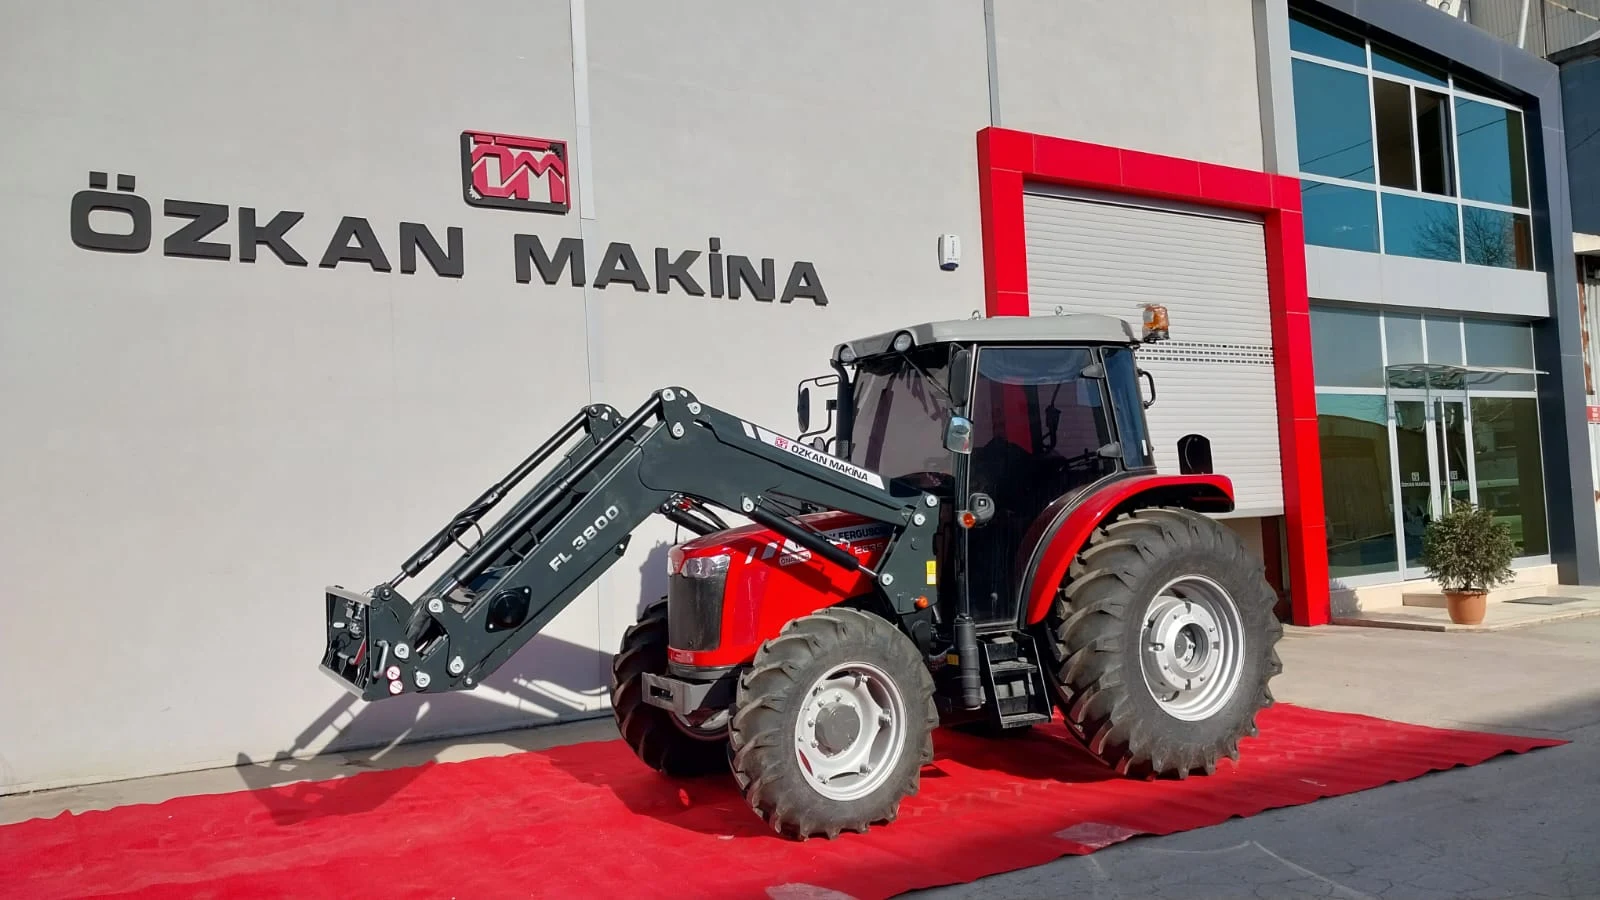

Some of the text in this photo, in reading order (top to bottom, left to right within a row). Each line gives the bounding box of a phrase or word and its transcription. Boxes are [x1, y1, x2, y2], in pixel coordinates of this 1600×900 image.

[70, 171, 829, 306] ÖZKAN MAKİNA
[549, 505, 619, 572] FL 3800
